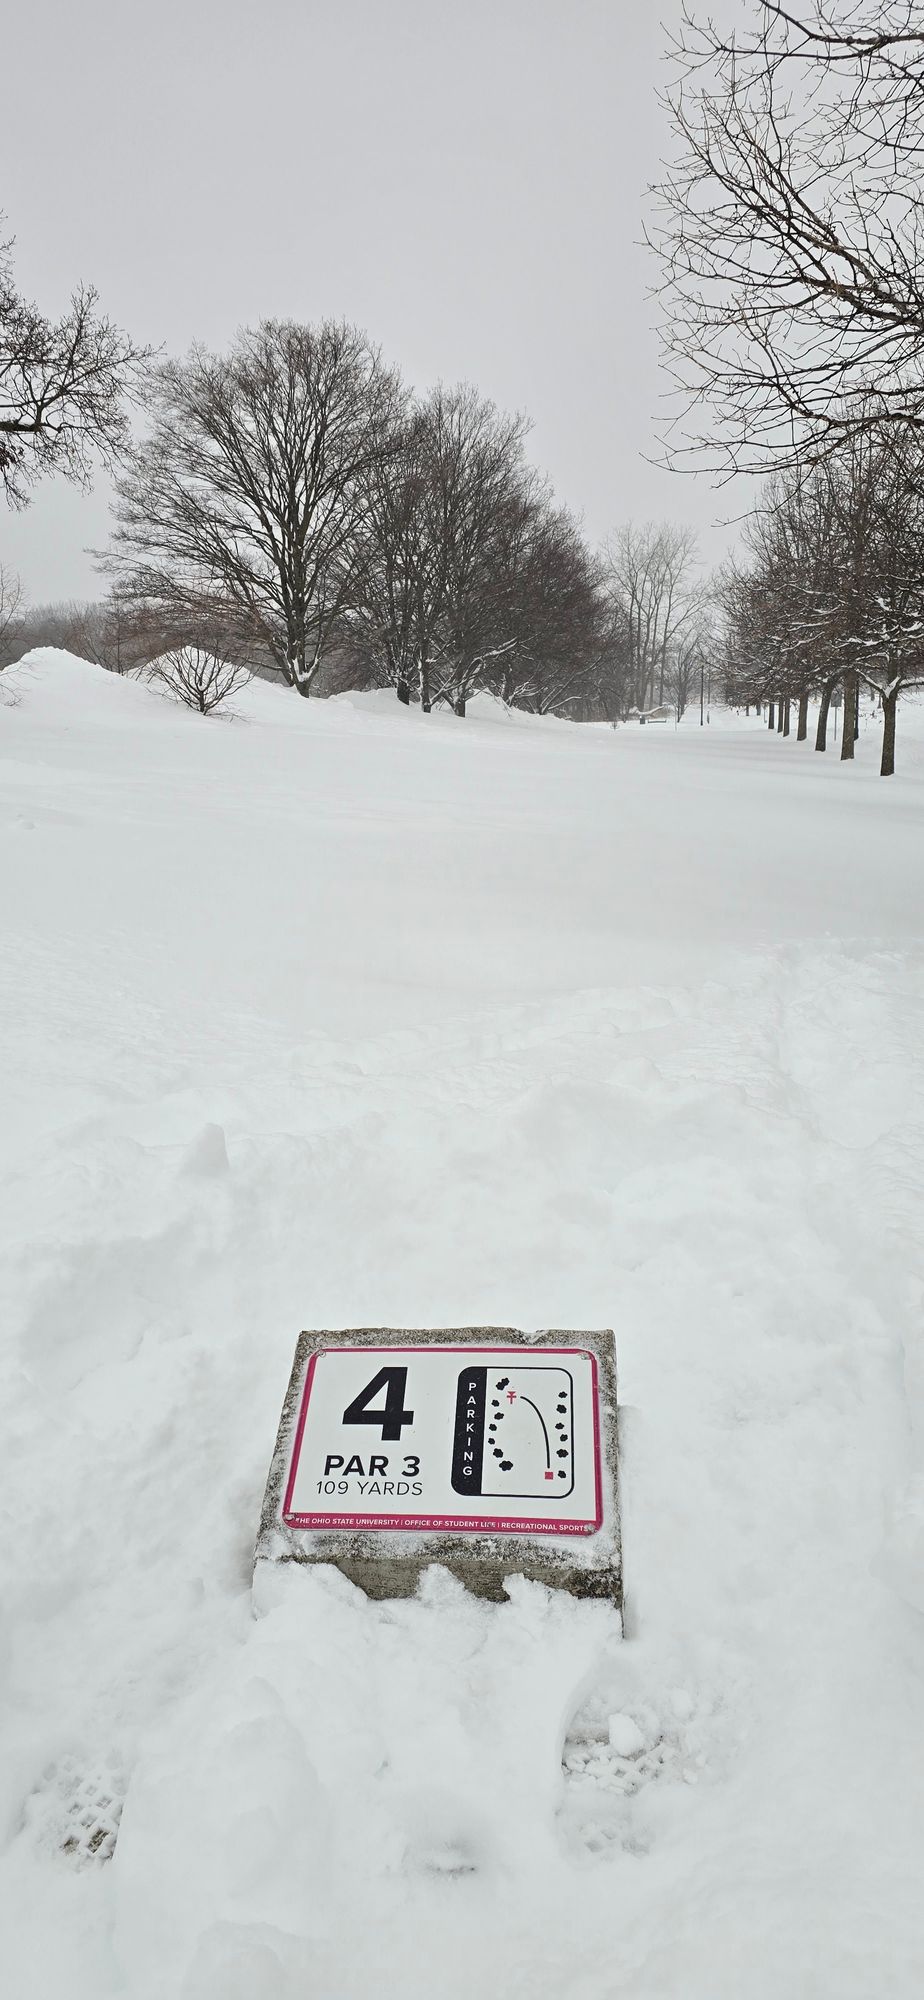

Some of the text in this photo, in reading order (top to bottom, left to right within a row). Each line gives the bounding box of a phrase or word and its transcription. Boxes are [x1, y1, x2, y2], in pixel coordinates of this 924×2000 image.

[342, 1366, 415, 1441] 4
[462, 1382, 477, 1476] PARKING
[324, 1455, 421, 1478] PAR 3
[316, 1481, 423, 1496] 109 YARDS
[332, 1518, 354, 1526] STATE
[404, 1519, 431, 1527] OFFICE
[433, 1519, 444, 1527] OF
[501, 1522, 557, 1531] RECREATIONAL
